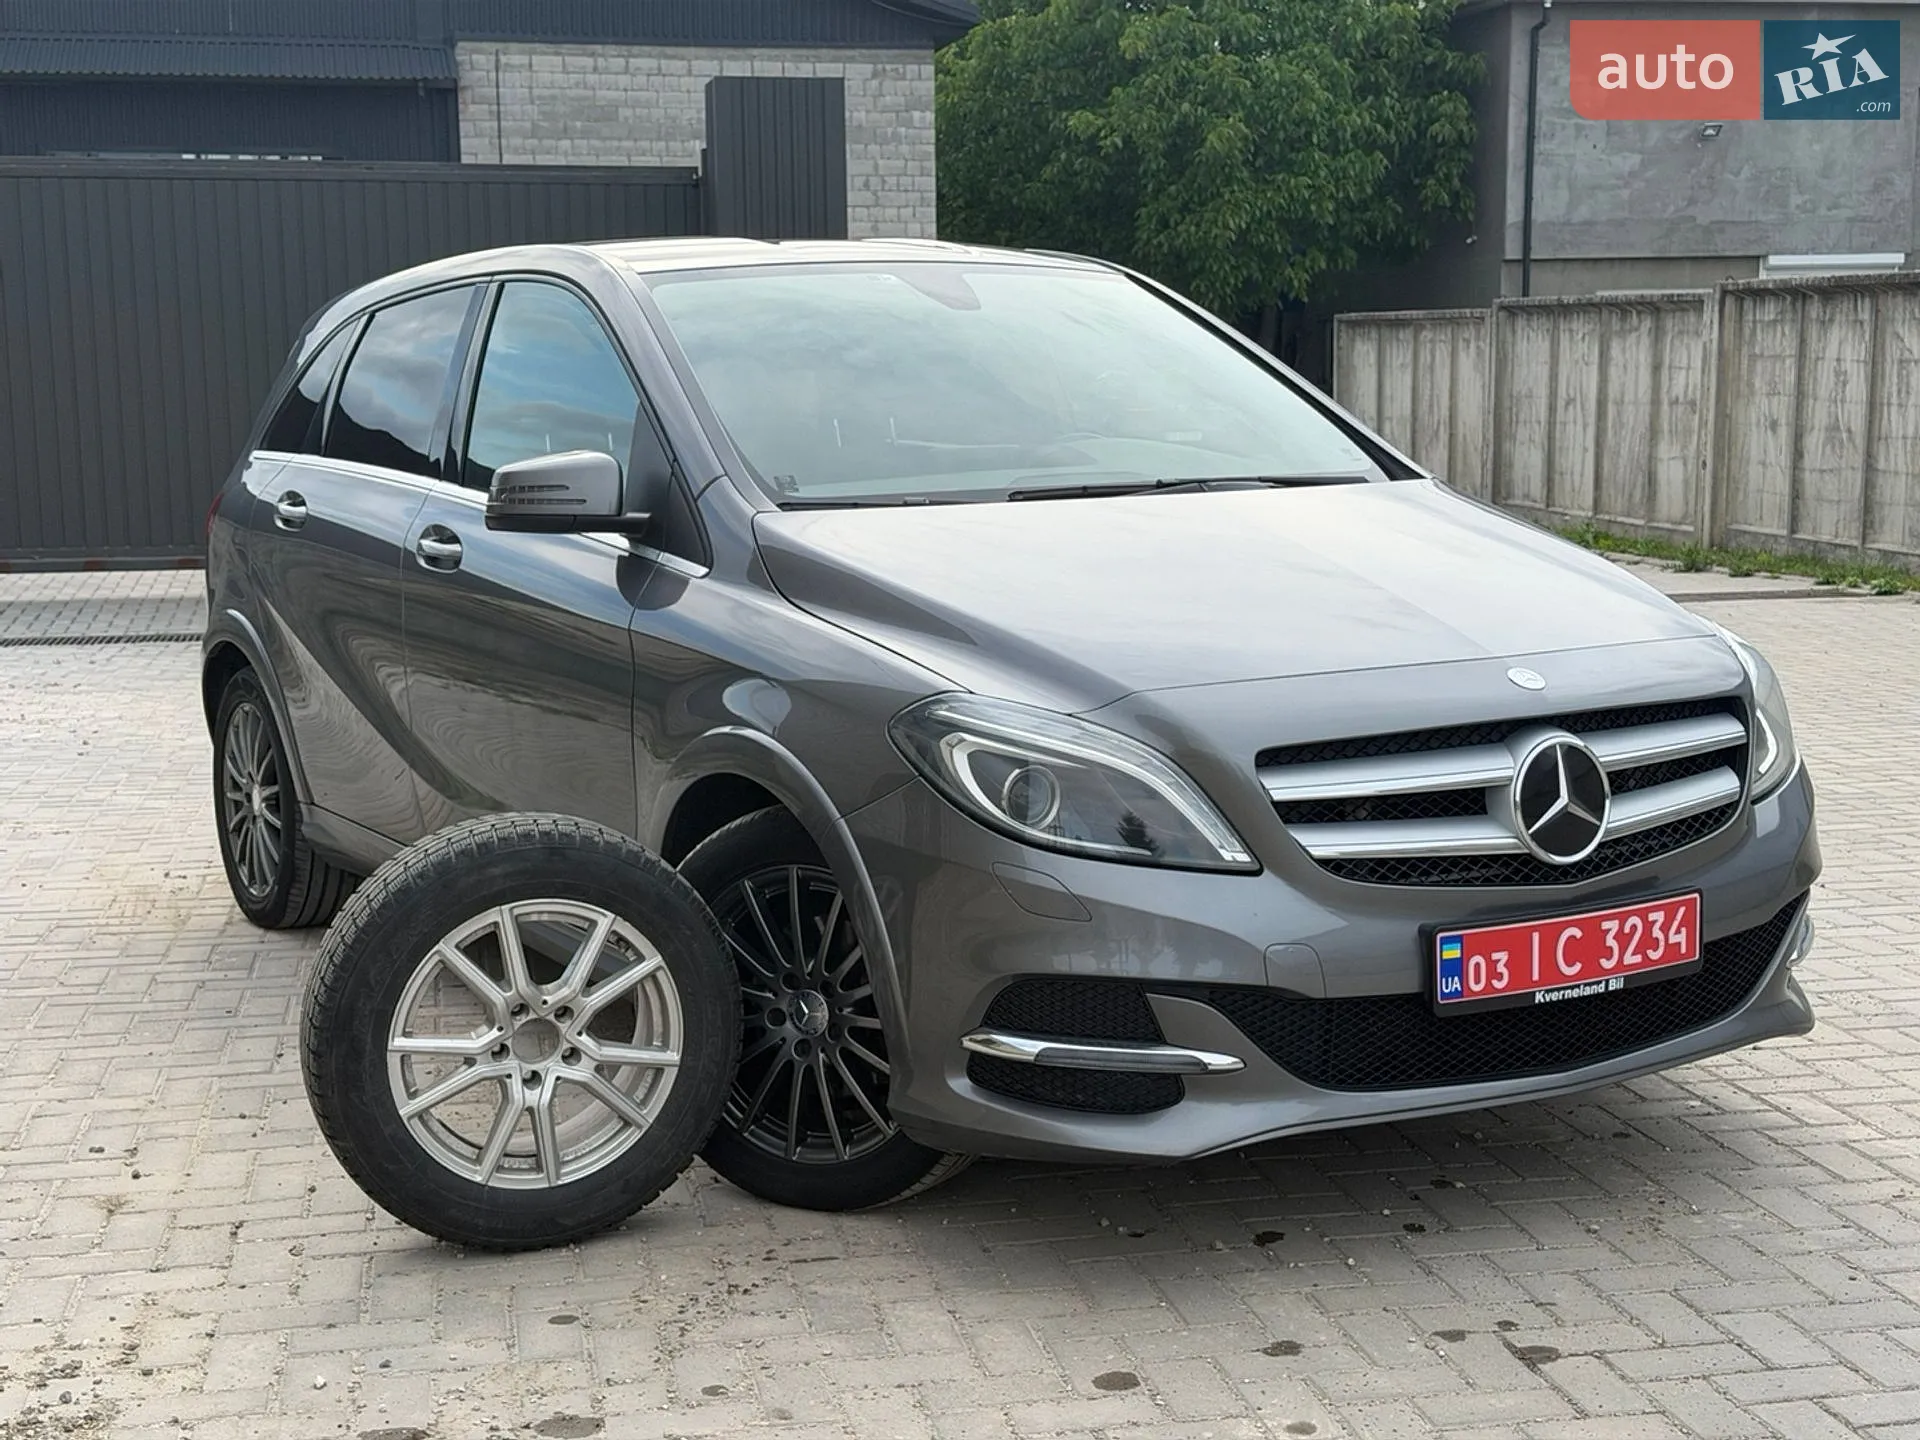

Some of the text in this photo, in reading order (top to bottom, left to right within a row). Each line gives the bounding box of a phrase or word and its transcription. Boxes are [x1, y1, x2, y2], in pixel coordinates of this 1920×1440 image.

[1599, 906, 1687, 969] 3234
[1442, 976, 1461, 993] UA
[1535, 976, 1625, 1004] Kverneland Bil
